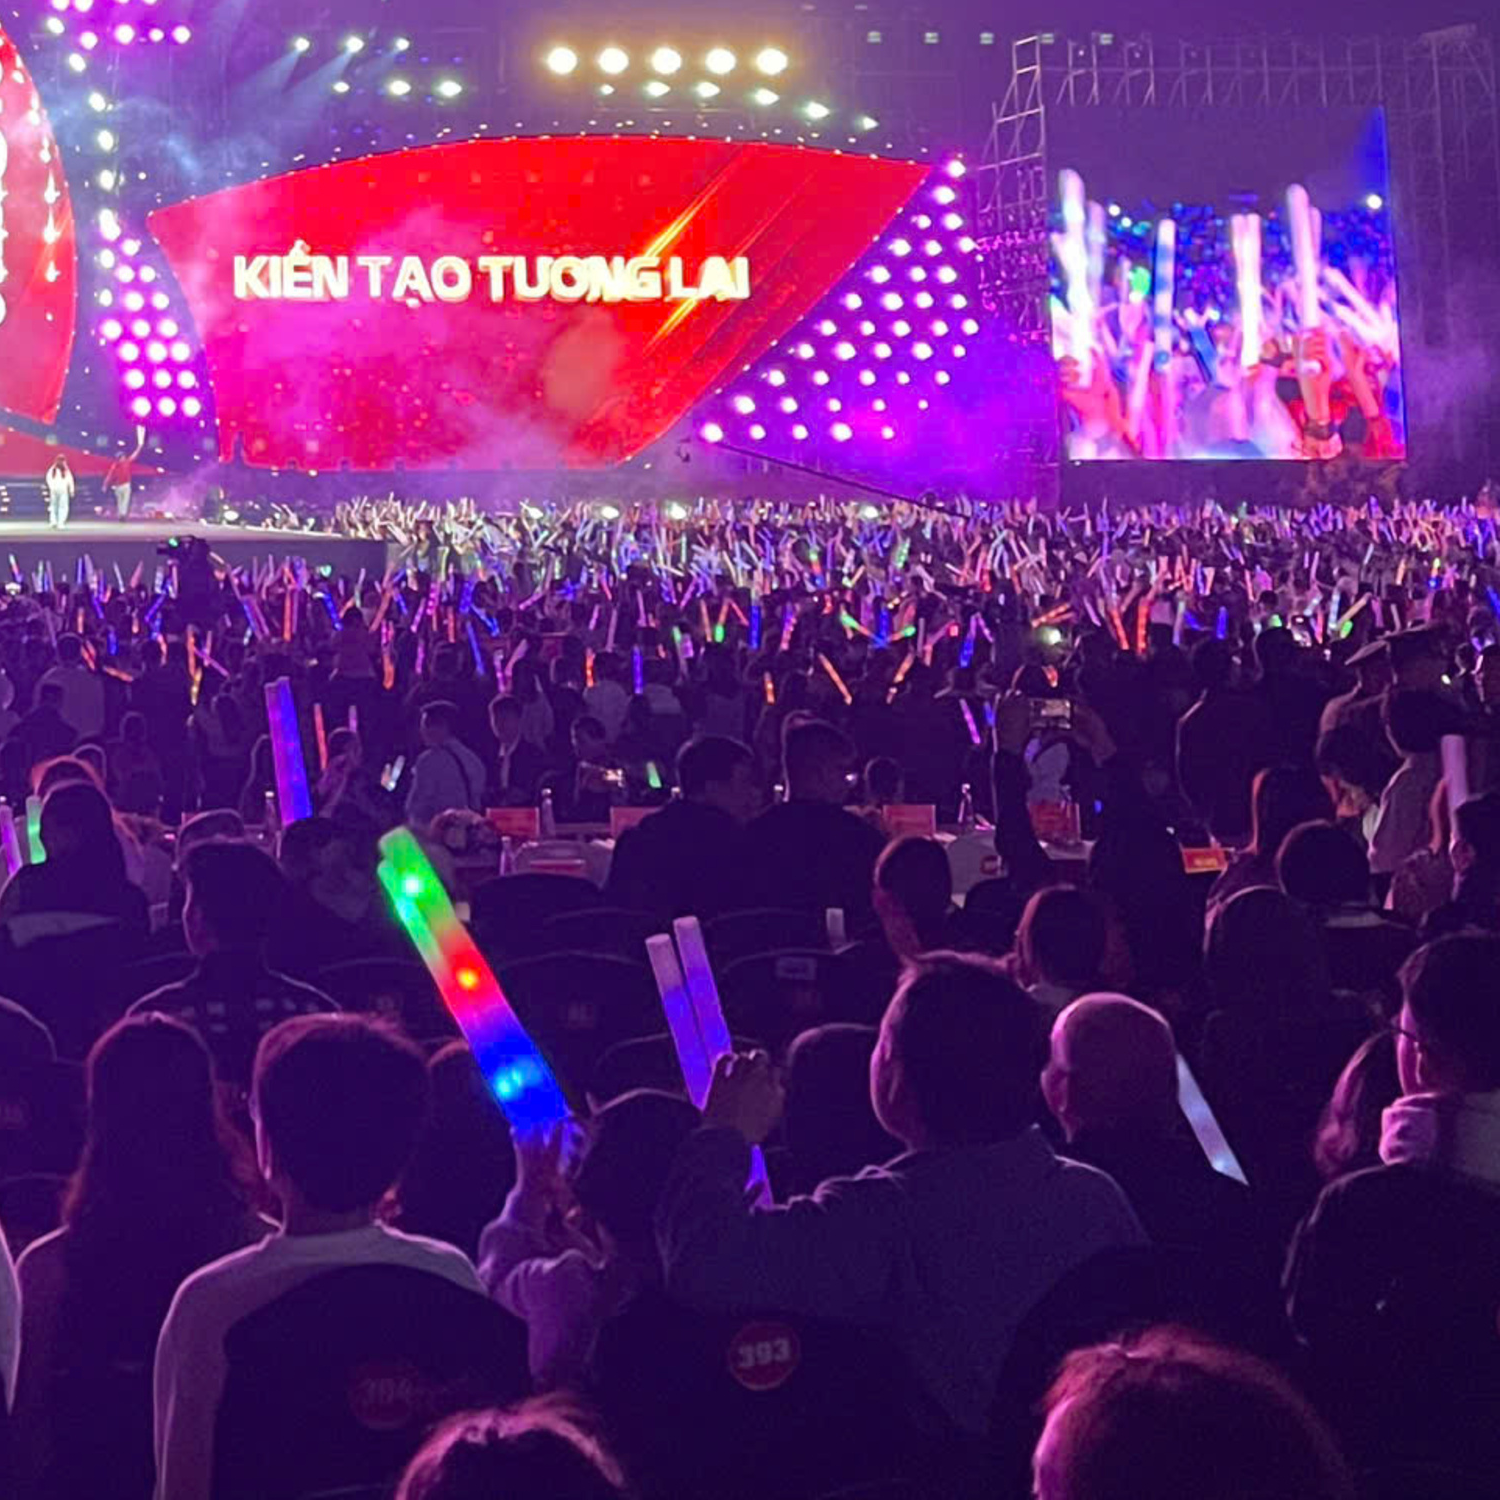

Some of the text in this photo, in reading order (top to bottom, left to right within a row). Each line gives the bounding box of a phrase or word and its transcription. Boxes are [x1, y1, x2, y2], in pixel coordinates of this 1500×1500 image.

[356, 256, 472, 308] TẠO
[665, 256, 750, 302] LAI
[738, 1337, 791, 1369] 393
